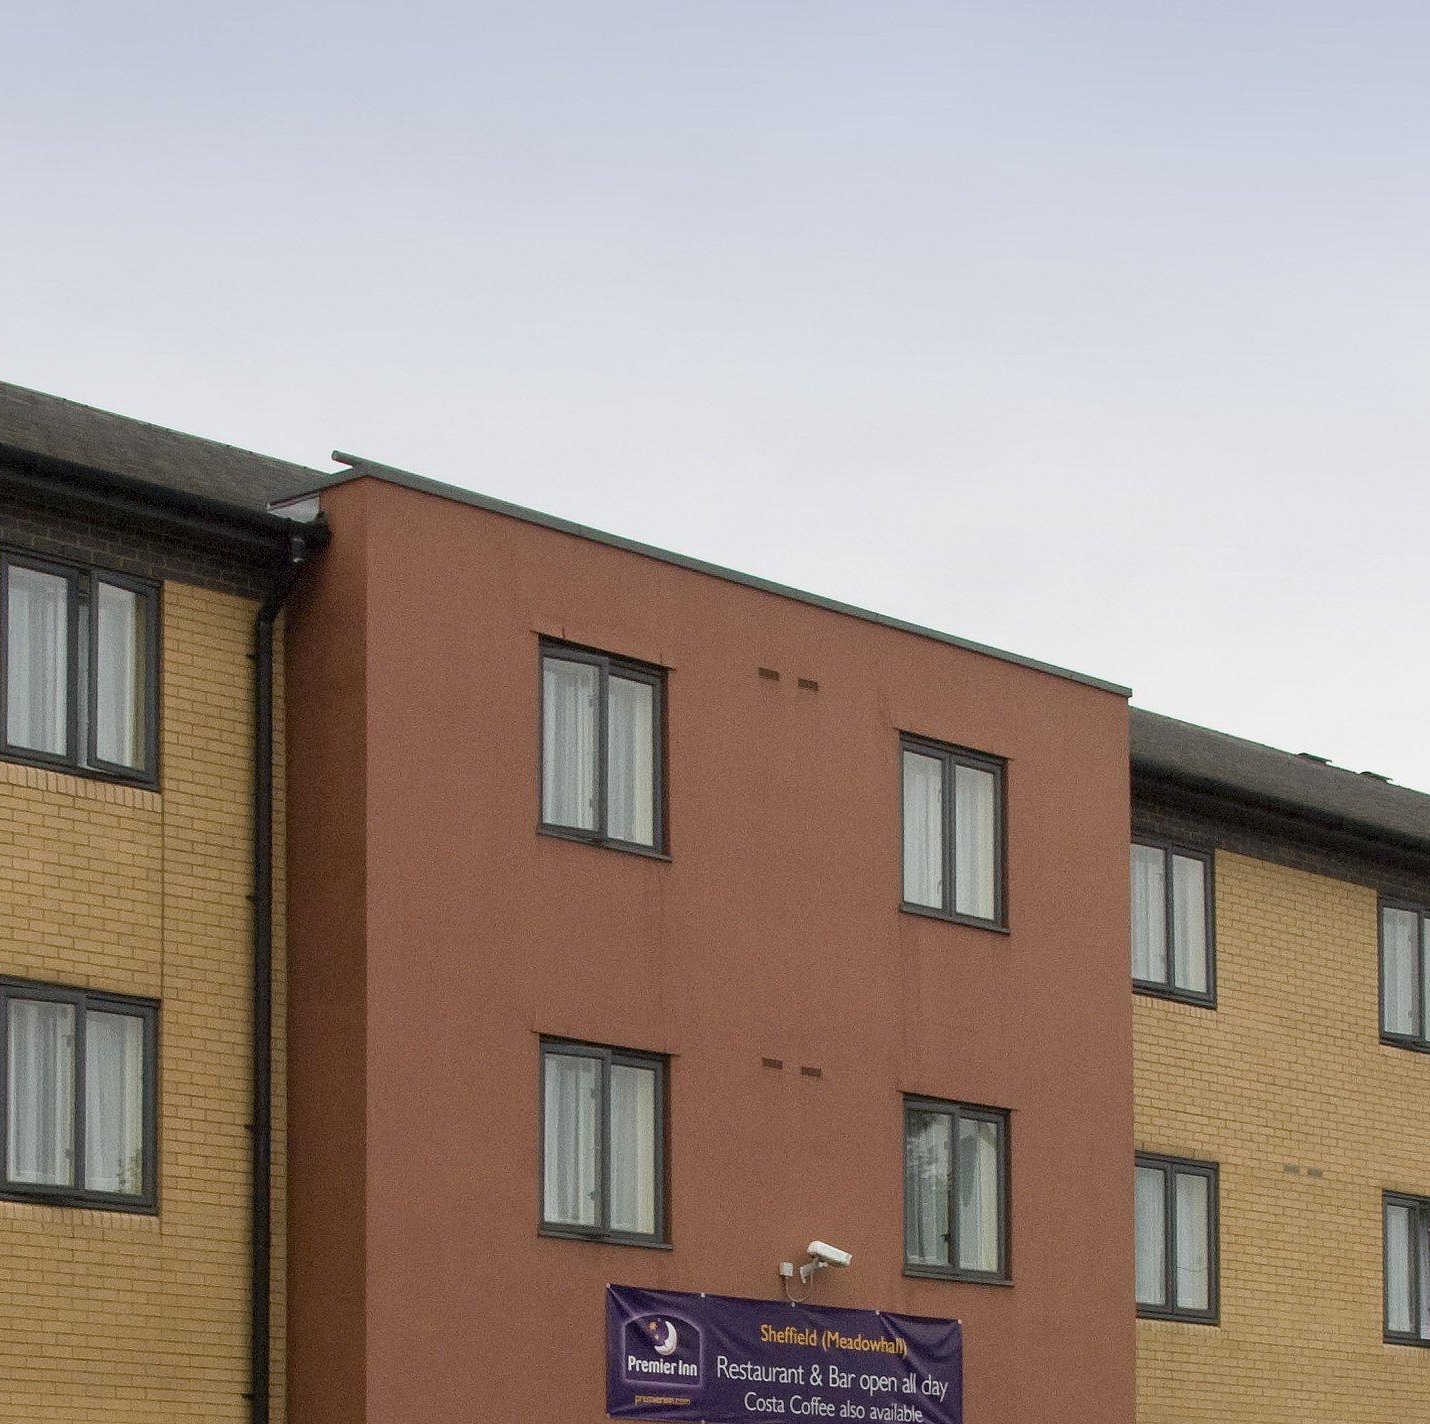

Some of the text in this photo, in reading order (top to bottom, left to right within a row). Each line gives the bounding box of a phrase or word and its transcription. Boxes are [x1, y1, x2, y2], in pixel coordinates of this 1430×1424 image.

[761, 1324, 908, 1359] Sheffield (Meadowhall)
[627, 1355, 698, 1377] Premier Inn
[717, 1355, 949, 1403] Restaurant & Bar open all day
[744, 1391, 924, 1423] Costa Coffee also available
